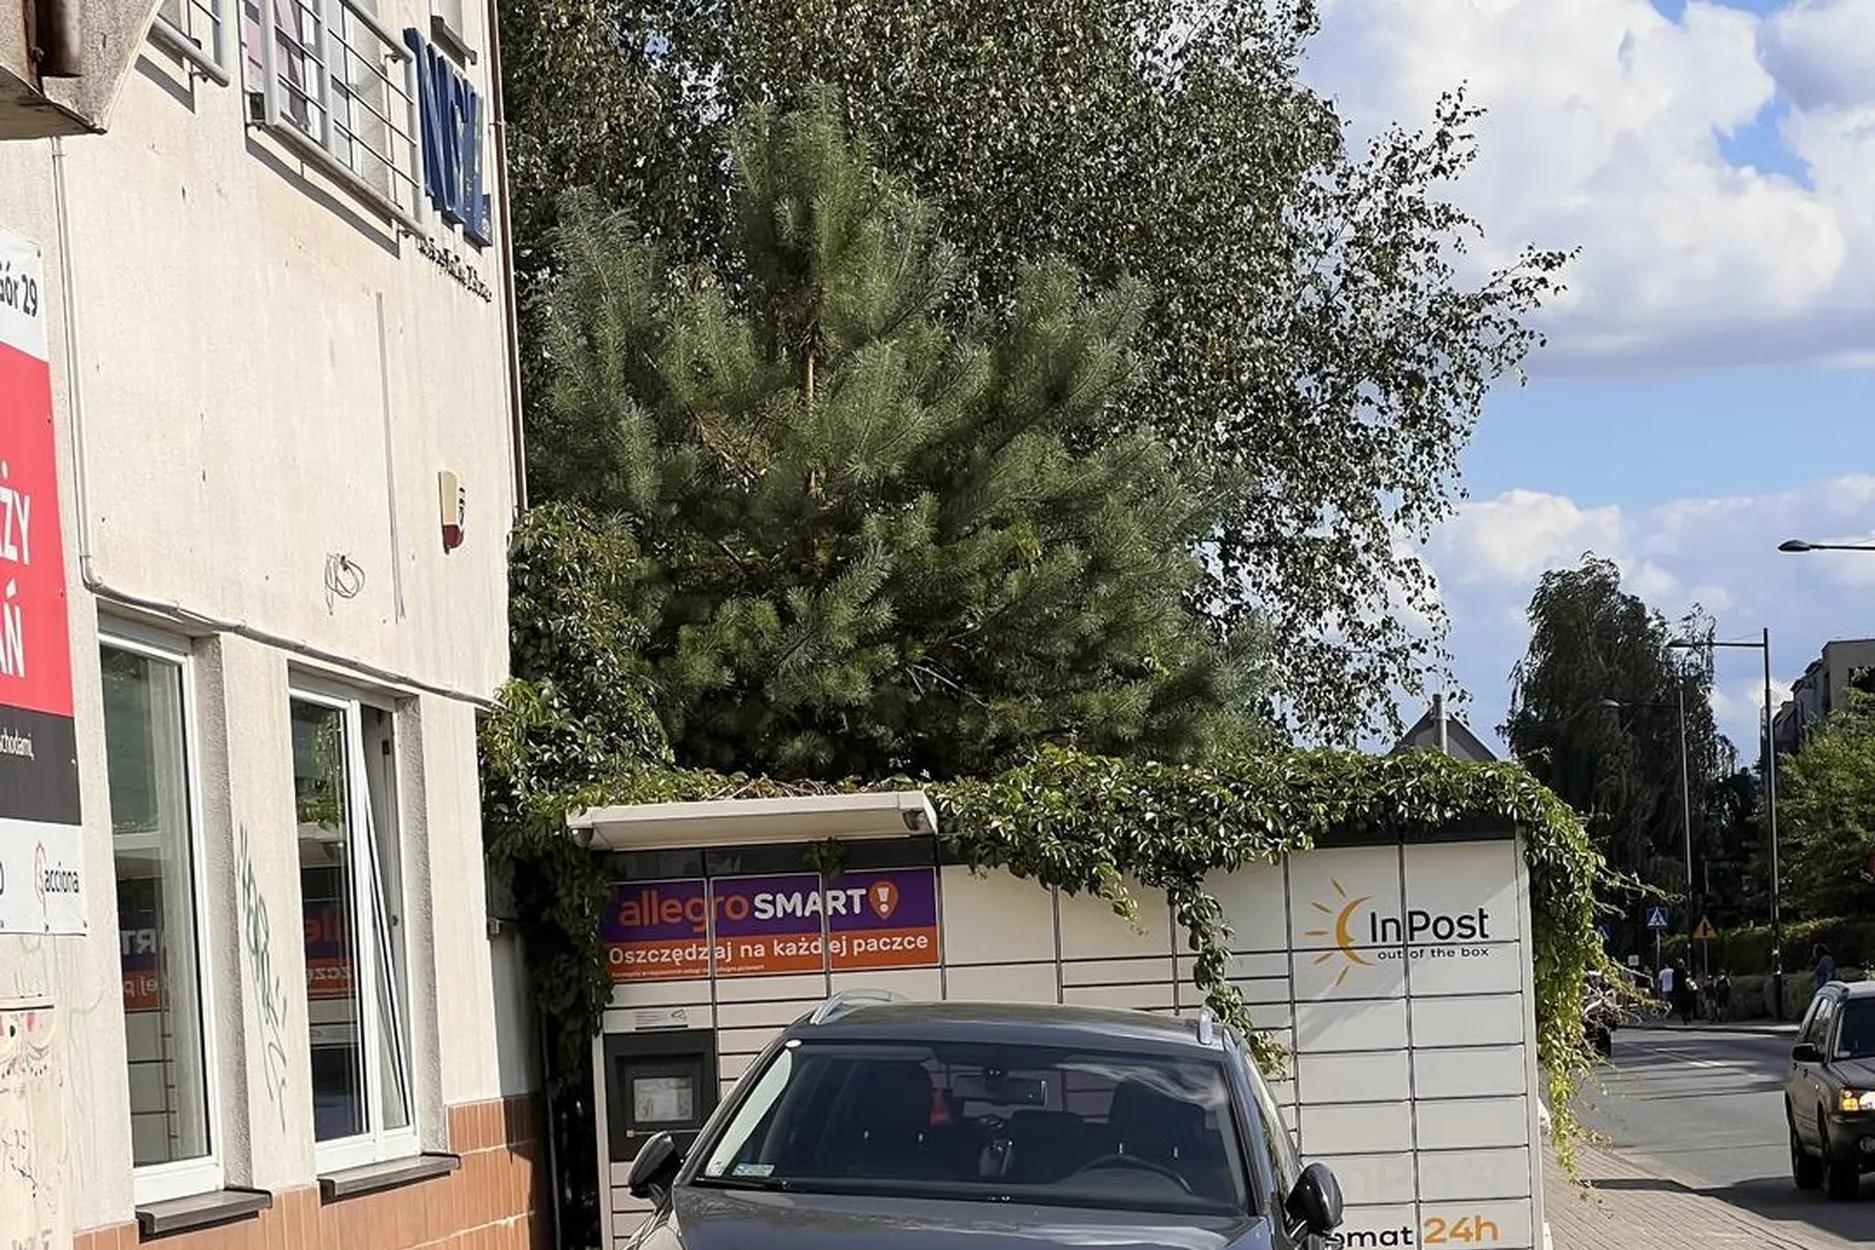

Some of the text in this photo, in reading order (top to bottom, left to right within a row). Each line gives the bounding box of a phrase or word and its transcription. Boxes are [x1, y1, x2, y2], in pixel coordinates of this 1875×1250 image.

[21, 274, 37, 317] 29
[44, 861, 79, 893] acciona
[619, 889, 749, 932] allegro
[1370, 907, 1489, 942] InPost
[609, 935, 928, 965] Oszczędzaj na każdej paczce
[1378, 947, 1489, 960] out of the box
[1423, 1215, 1499, 1244] 24h
